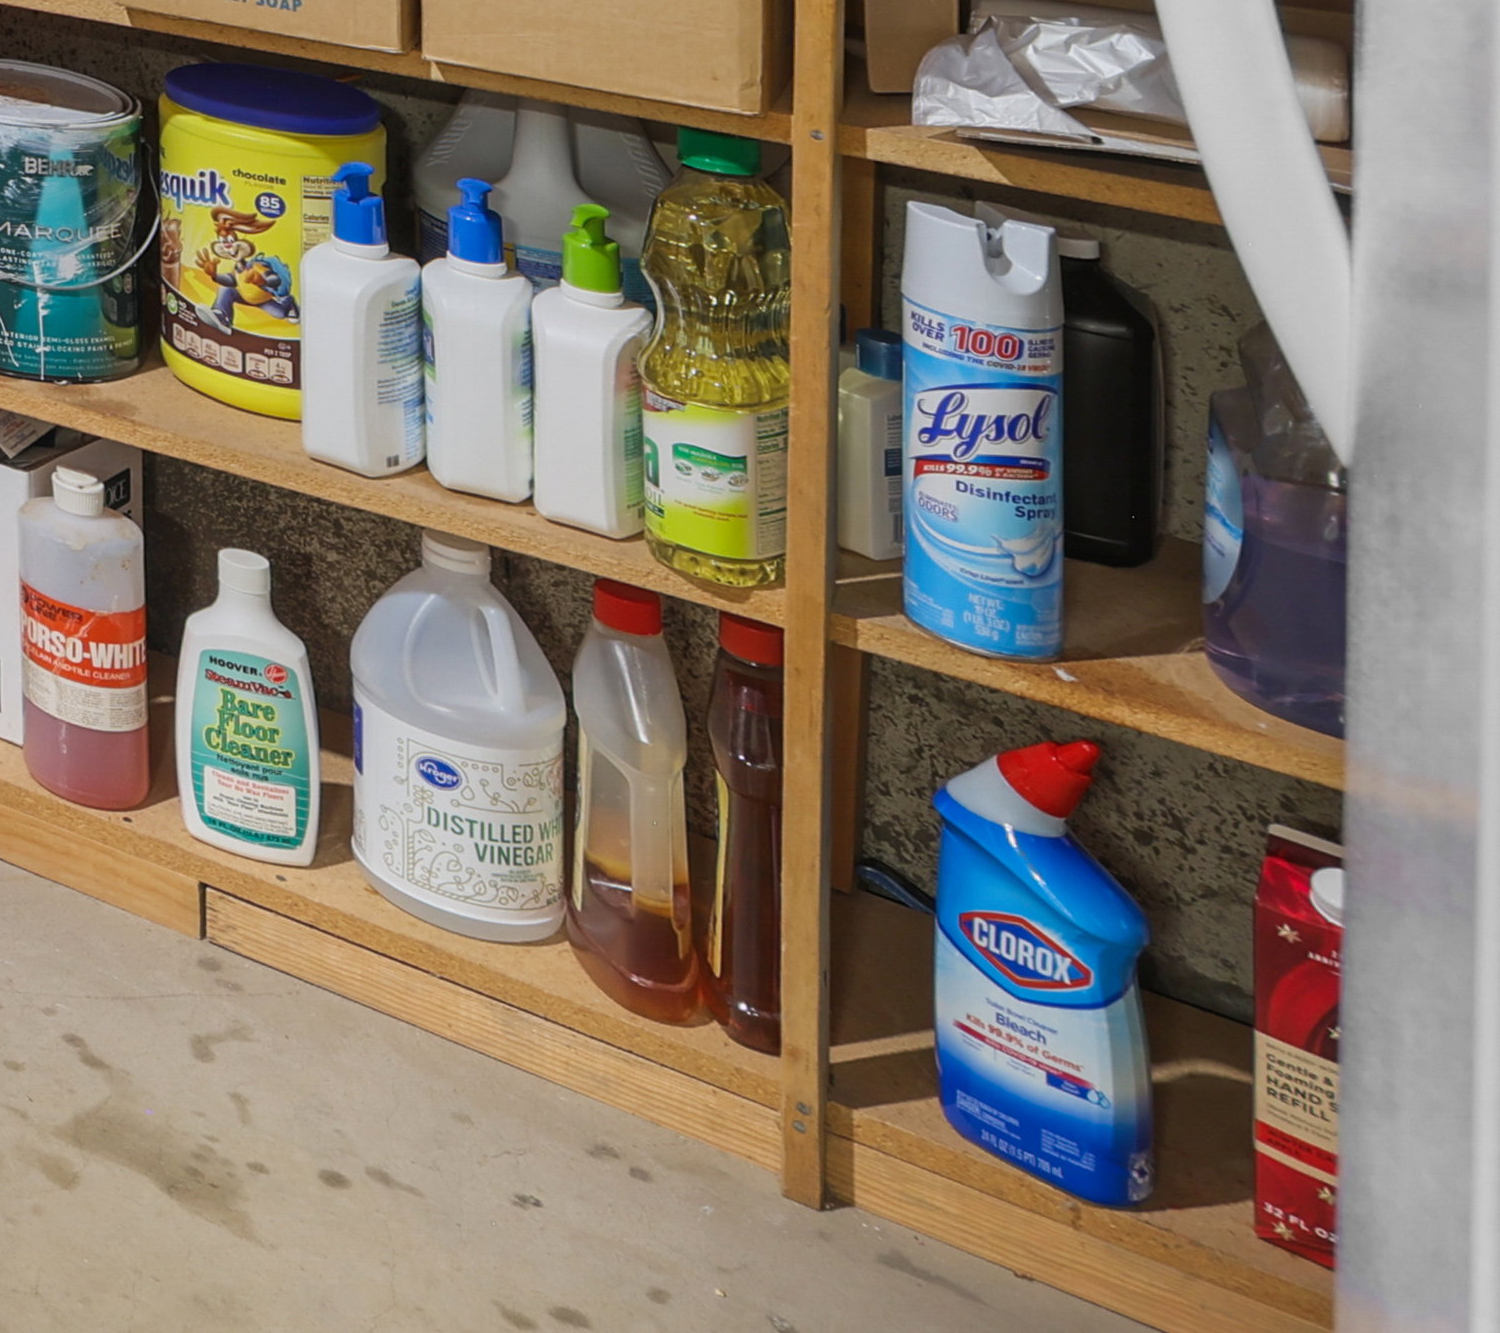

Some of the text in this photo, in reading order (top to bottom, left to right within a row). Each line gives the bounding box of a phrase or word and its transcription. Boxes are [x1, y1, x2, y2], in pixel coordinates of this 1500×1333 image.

[25, 157, 72, 176] BEHR
[232, 169, 286, 185] chocolate
[911, 310, 945, 332] KILLS
[912, 322, 945, 342] OVER
[952, 325, 1020, 361] 100
[917, 391, 1050, 460] Lysol
[946, 463, 992, 477] 99.9%
[209, 655, 258, 676] HOOVER
[220, 687, 275, 721] Bare
[218, 707, 280, 743] Floor
[205, 726, 293, 767] Cleaner
[426, 805, 535, 847] DISTILLED
[474, 838, 555, 868] VINEGAR
[972, 919, 1072, 985] CLOROX
[995, 1012, 1047, 1045] Bleach
[1265, 1067, 1336, 1099] Foaming
[1266, 1053, 1333, 1086] Gentle &
[1266, 1076, 1322, 1107] HAND
[1266, 1088, 1331, 1123] REFILL
